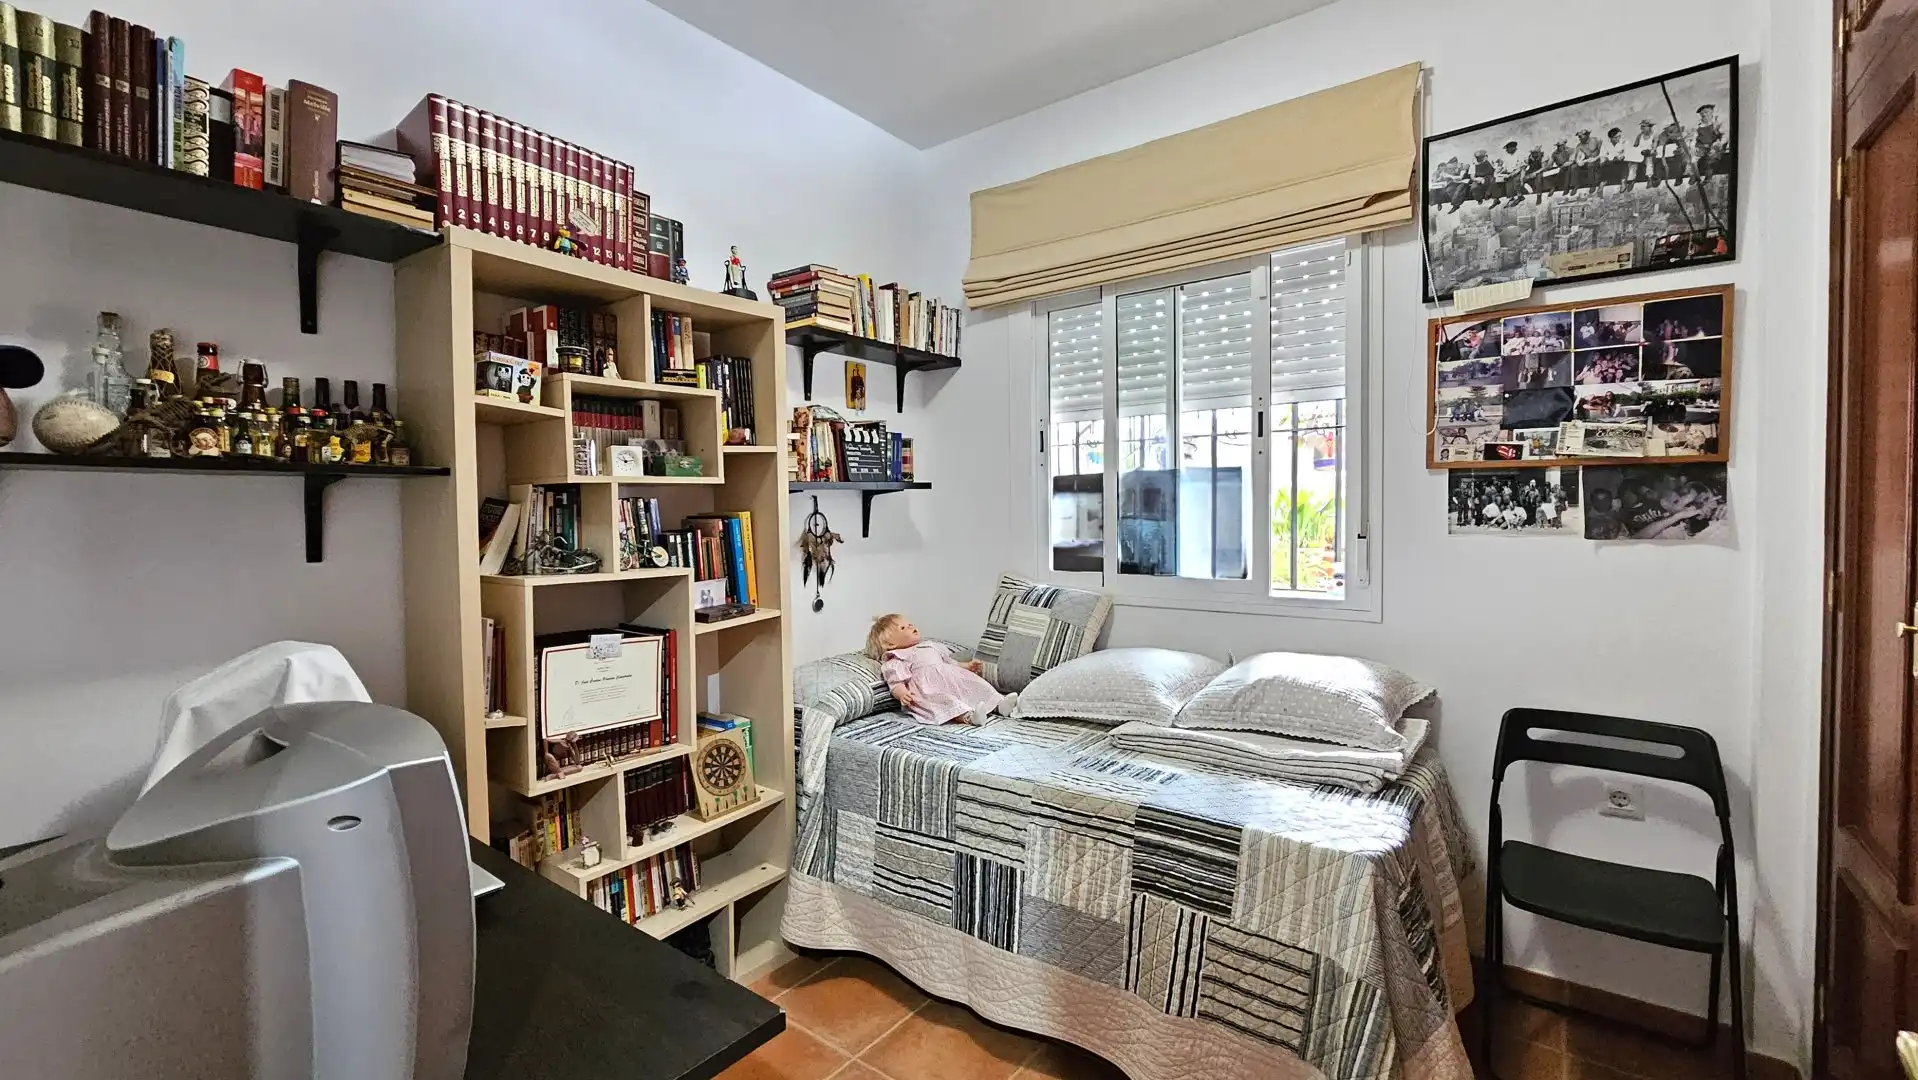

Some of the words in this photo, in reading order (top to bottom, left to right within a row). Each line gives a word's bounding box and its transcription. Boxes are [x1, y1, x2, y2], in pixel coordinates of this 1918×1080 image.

[444, 205, 449, 215] 1
[458, 209, 466, 219] 2
[474, 214, 480, 223] 3
[488, 217, 496, 226] 4
[504, 221, 510, 230] 5
[516, 225, 524, 235] 6
[530, 229, 537, 238] 7
[544, 232, 550, 241] 8
[592, 247, 601, 257] 12
[606, 250, 613, 259] 13
[618, 253, 625, 262] 14
